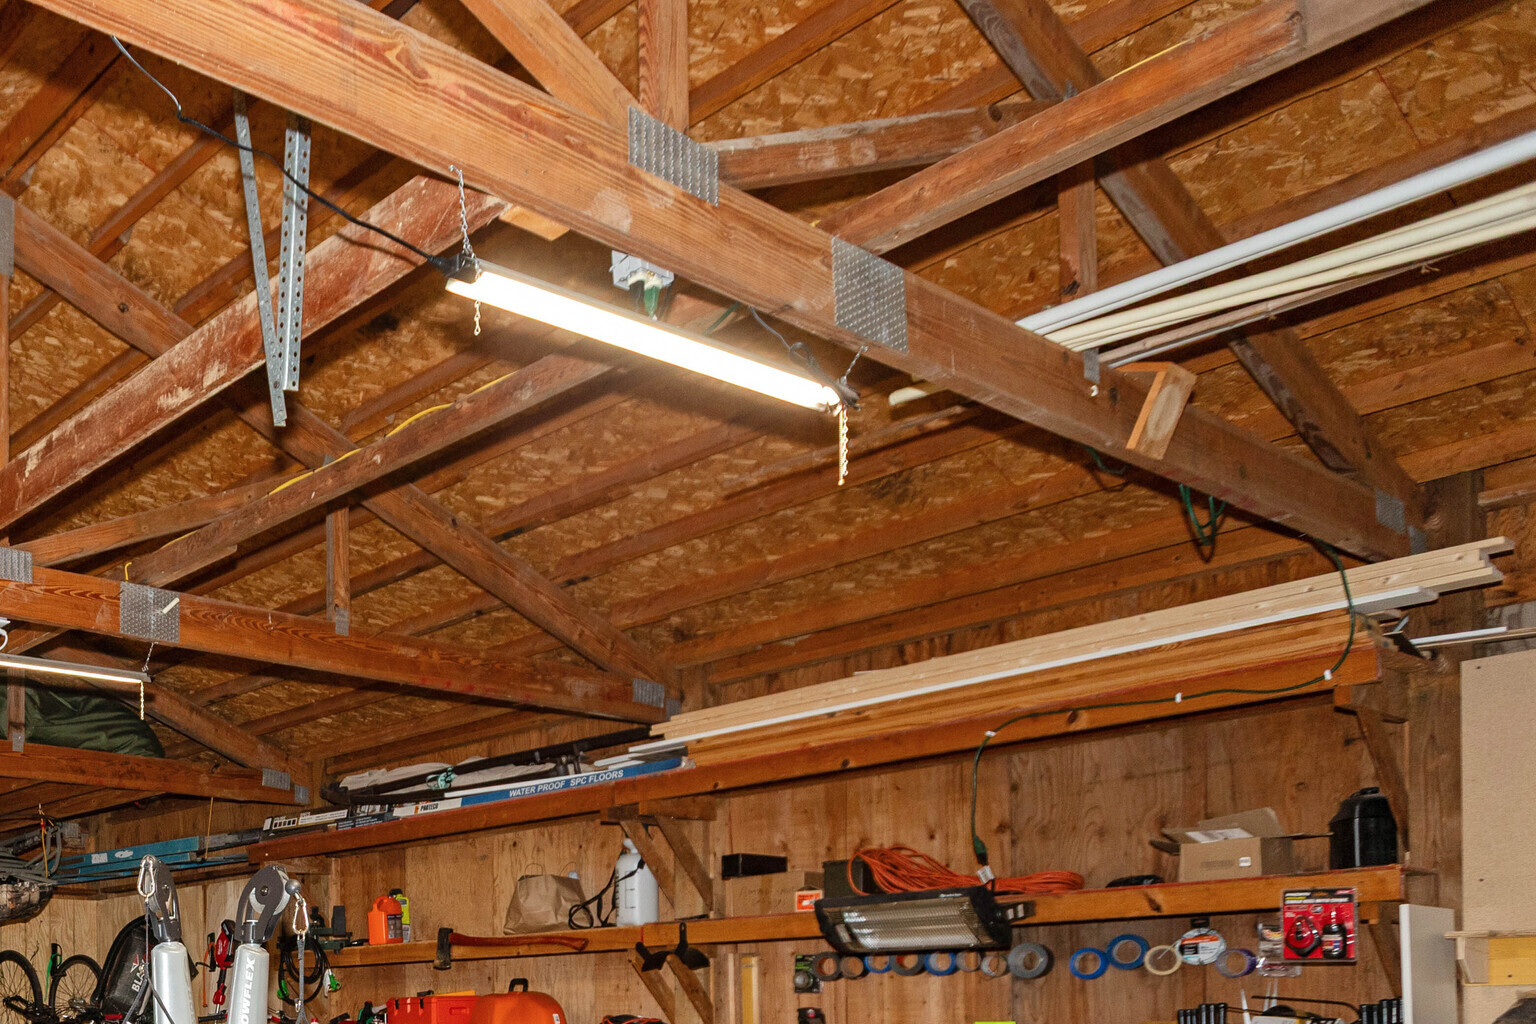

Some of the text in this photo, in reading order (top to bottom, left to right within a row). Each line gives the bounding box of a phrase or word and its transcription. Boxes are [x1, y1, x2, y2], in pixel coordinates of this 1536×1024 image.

[509, 768, 624, 798] WATER PROOF SPC FLOORS
